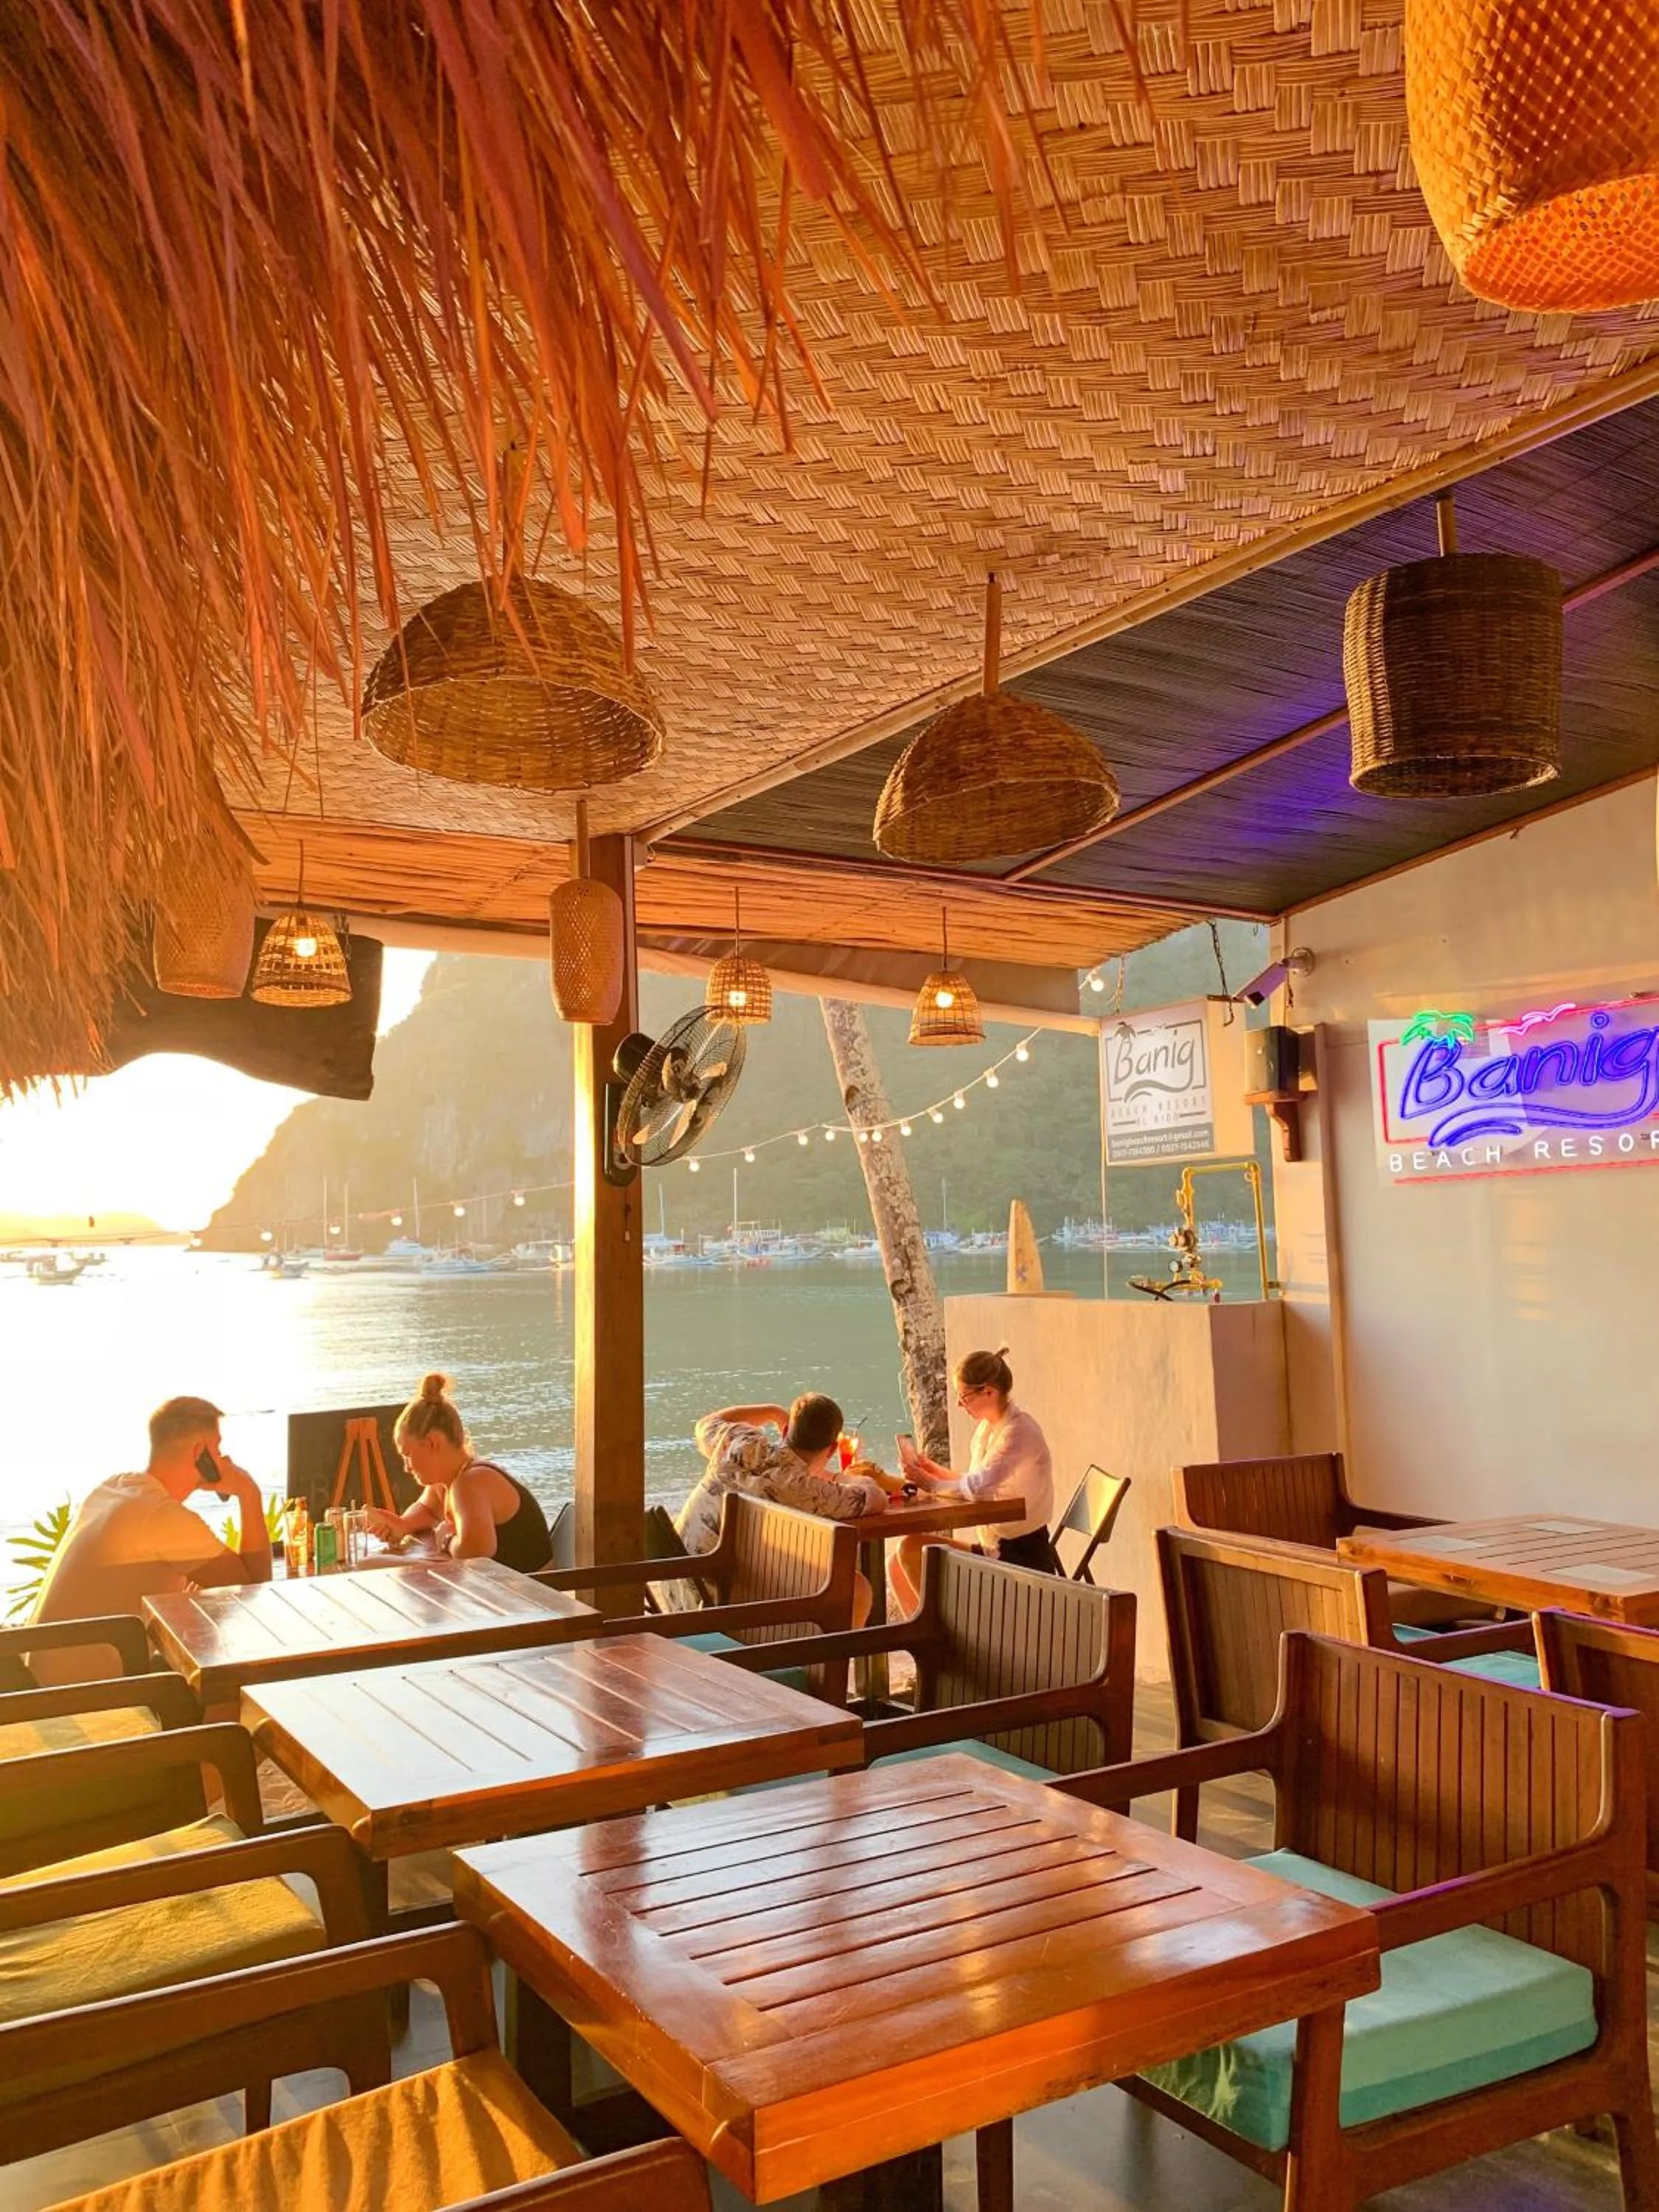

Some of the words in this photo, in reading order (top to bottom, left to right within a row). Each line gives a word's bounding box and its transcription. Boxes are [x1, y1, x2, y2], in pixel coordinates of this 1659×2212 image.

[1114, 1029, 1194, 1096] Banig
[1400, 1012, 1659, 1143] Banig
[1389, 1147, 1502, 1172] BEACH
